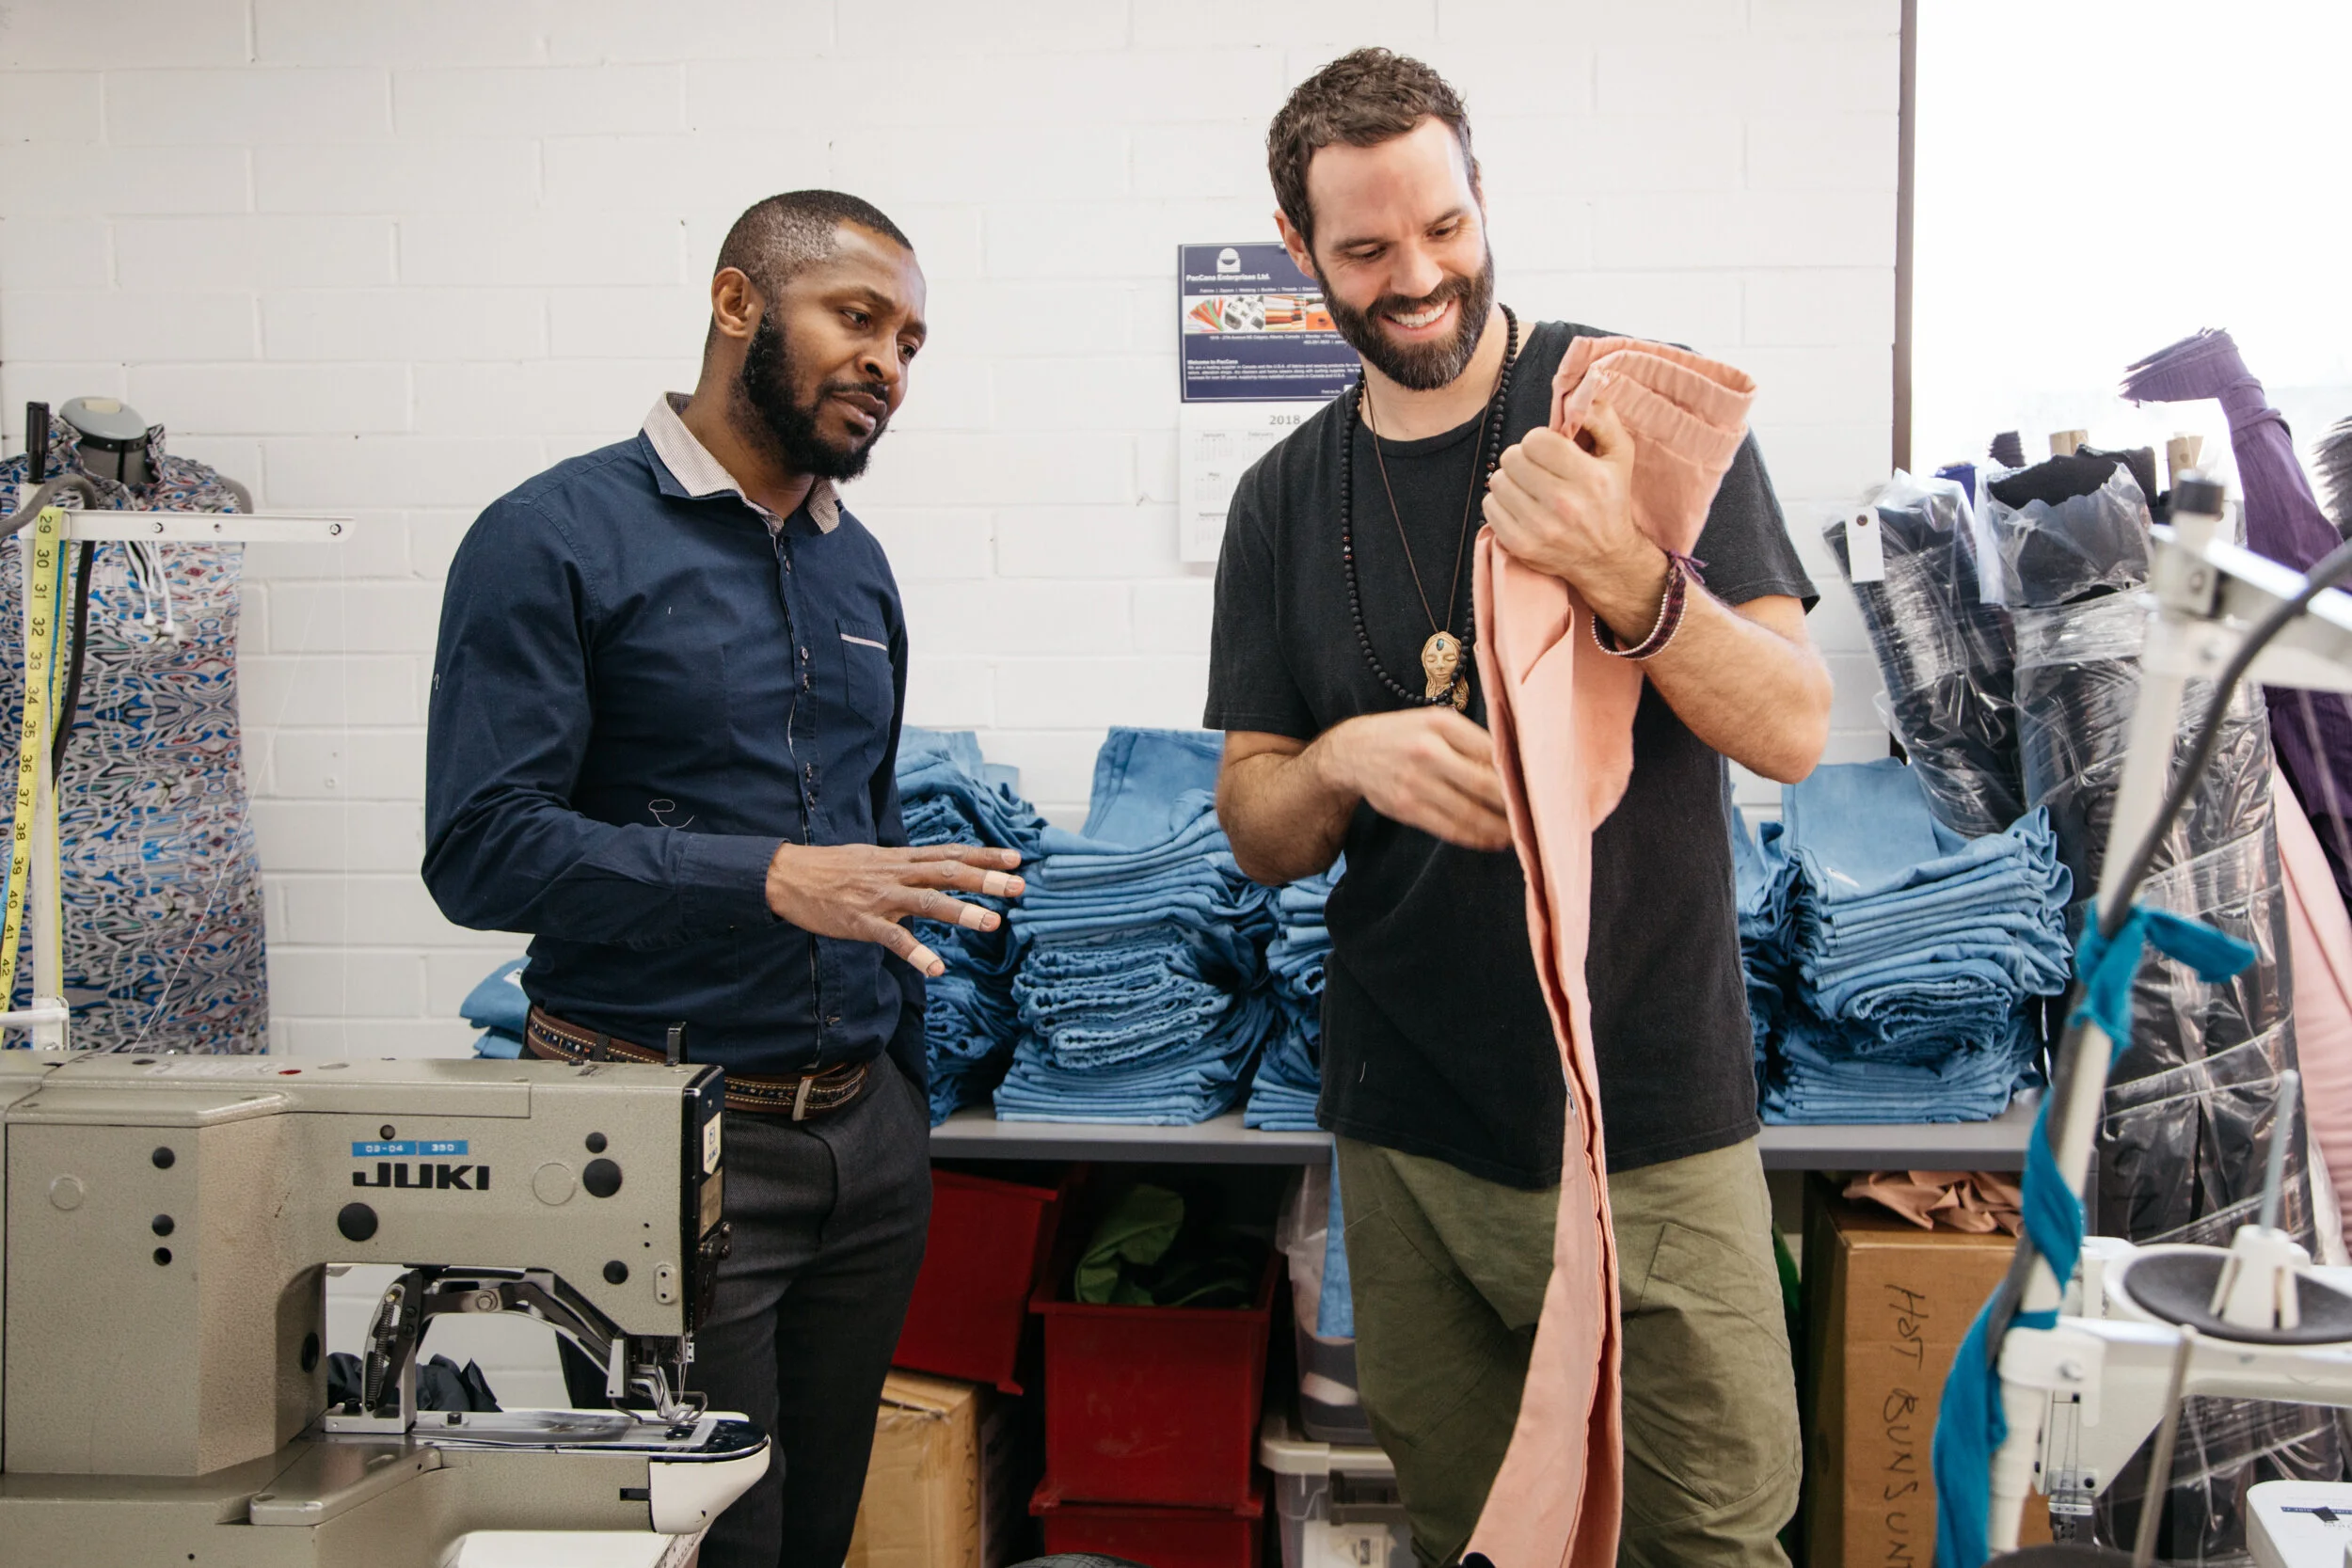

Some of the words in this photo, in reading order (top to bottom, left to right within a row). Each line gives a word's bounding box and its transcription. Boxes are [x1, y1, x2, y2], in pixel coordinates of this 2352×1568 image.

[1216, 274, 1256, 282] Enterprises
[1269, 415, 1301, 425] 2018
[39, 515, 53, 534] 29
[36, 549, 50, 569] 30
[34, 583, 48, 600] 31
[31, 617, 45, 636] 32
[29, 652, 43, 671] 33
[26, 686, 40, 705] 34
[24, 721, 37, 738] 35
[21, 754, 33, 773] 36
[18, 788, 30, 807] 37
[15, 822, 26, 842] 38
[12, 857, 24, 876] 39
[8, 890, 20, 910] 40
[5, 925, 15, 941] 41
[1, 958, 11, 977] 42
[352, 1162, 490, 1191] JUKI
[1884, 1284, 1929, 1370] HOT
